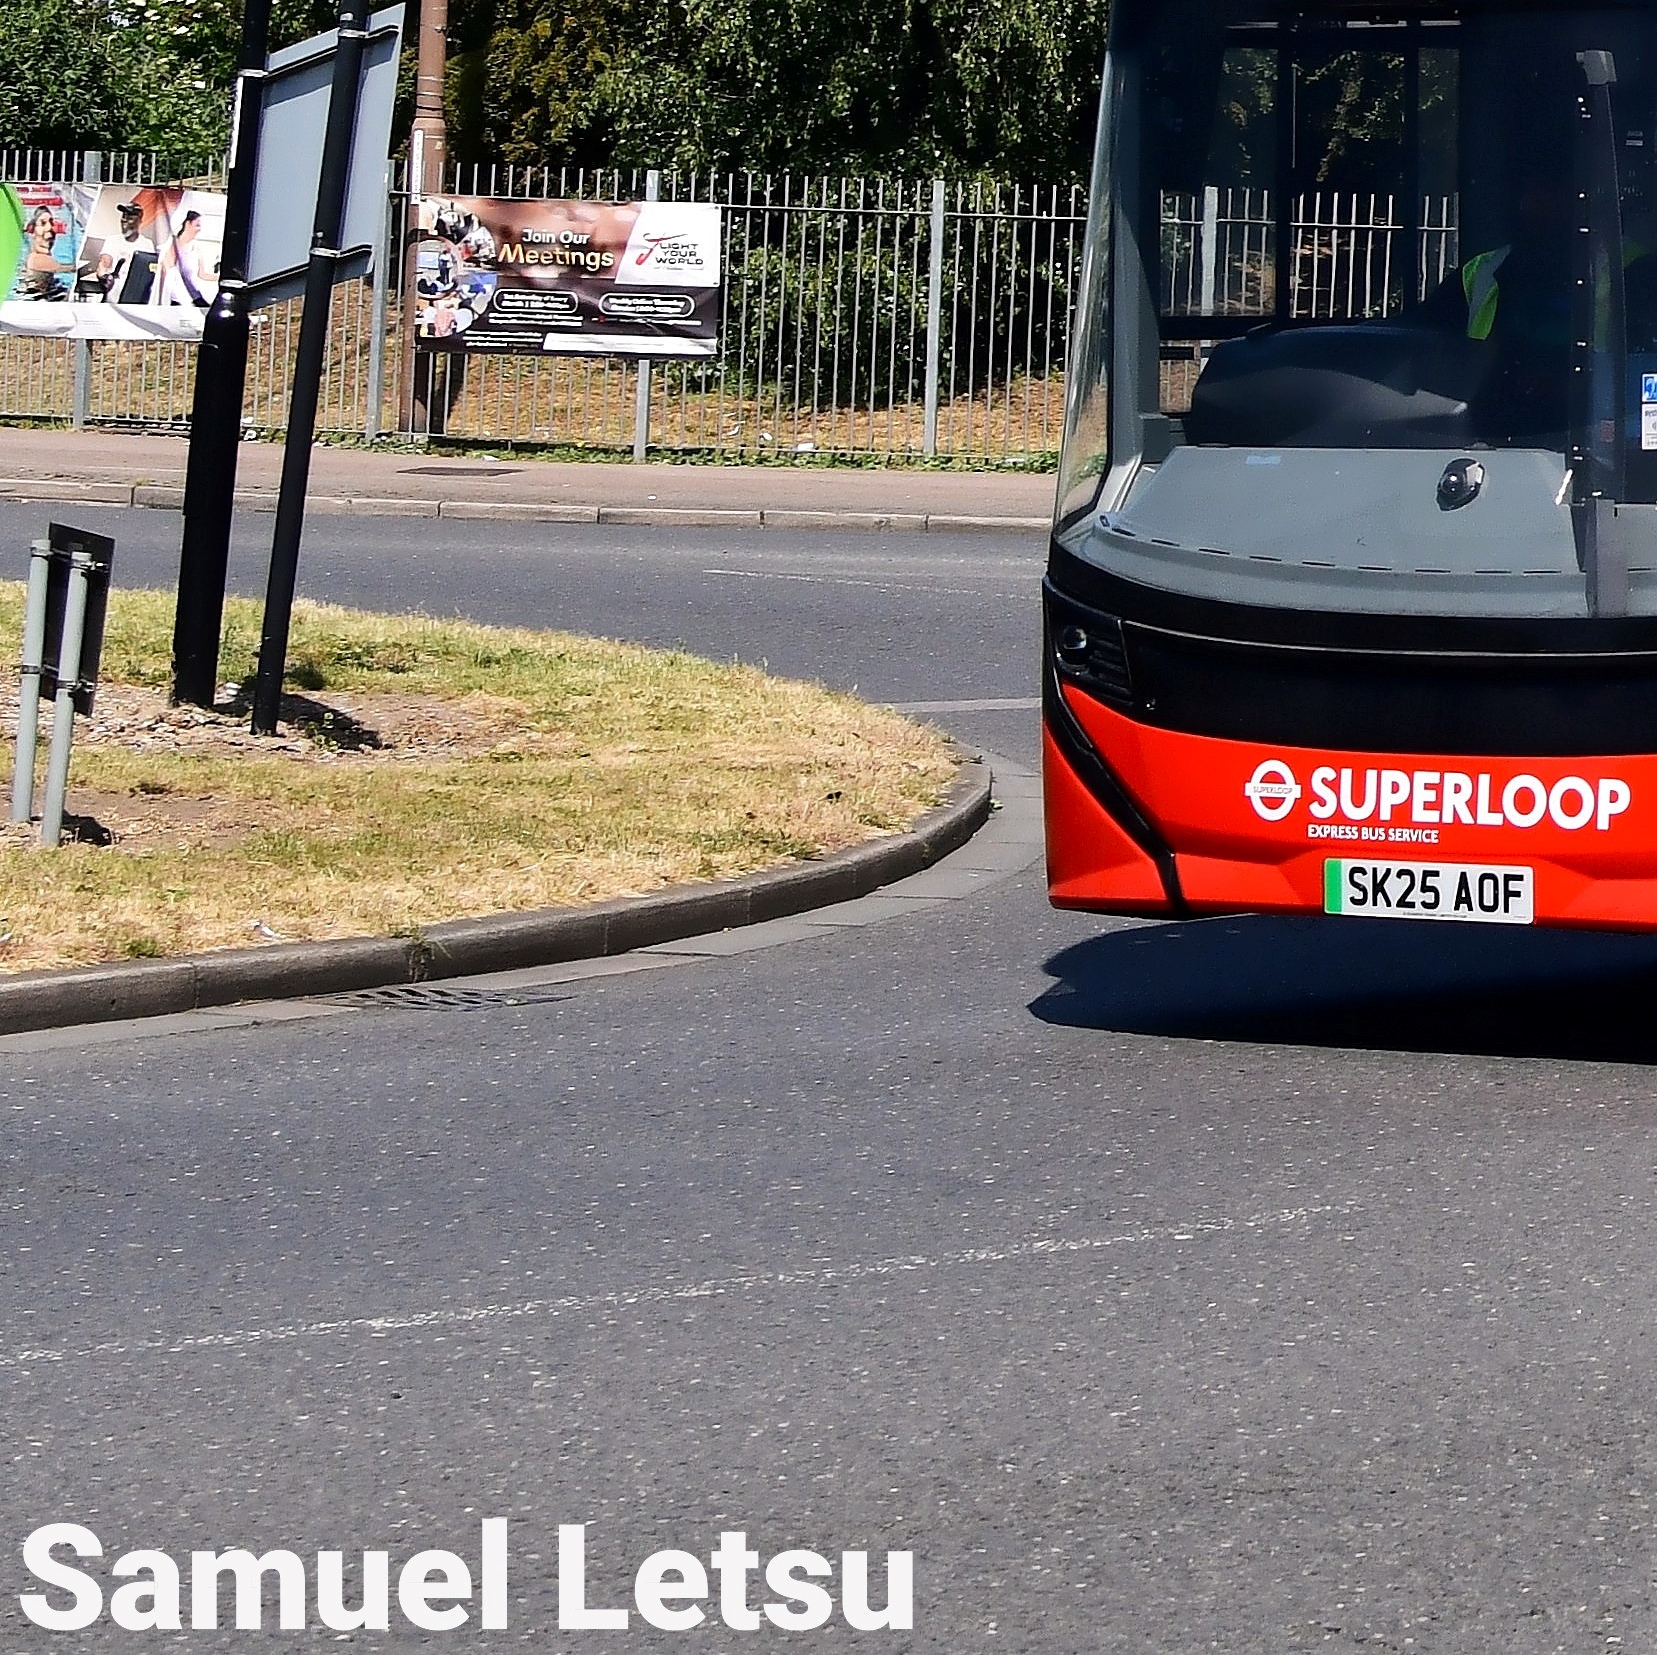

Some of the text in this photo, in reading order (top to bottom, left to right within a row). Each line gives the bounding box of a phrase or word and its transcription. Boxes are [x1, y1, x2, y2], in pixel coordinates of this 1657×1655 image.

[522, 229, 590, 244] Join Our
[498, 243, 615, 271] Meetings
[1309, 765, 1631, 830] SUPERLOOP
[1308, 824, 1439, 844] EXPRESS BUS SERVICE
[1348, 866, 1524, 913] SK25 AOF
